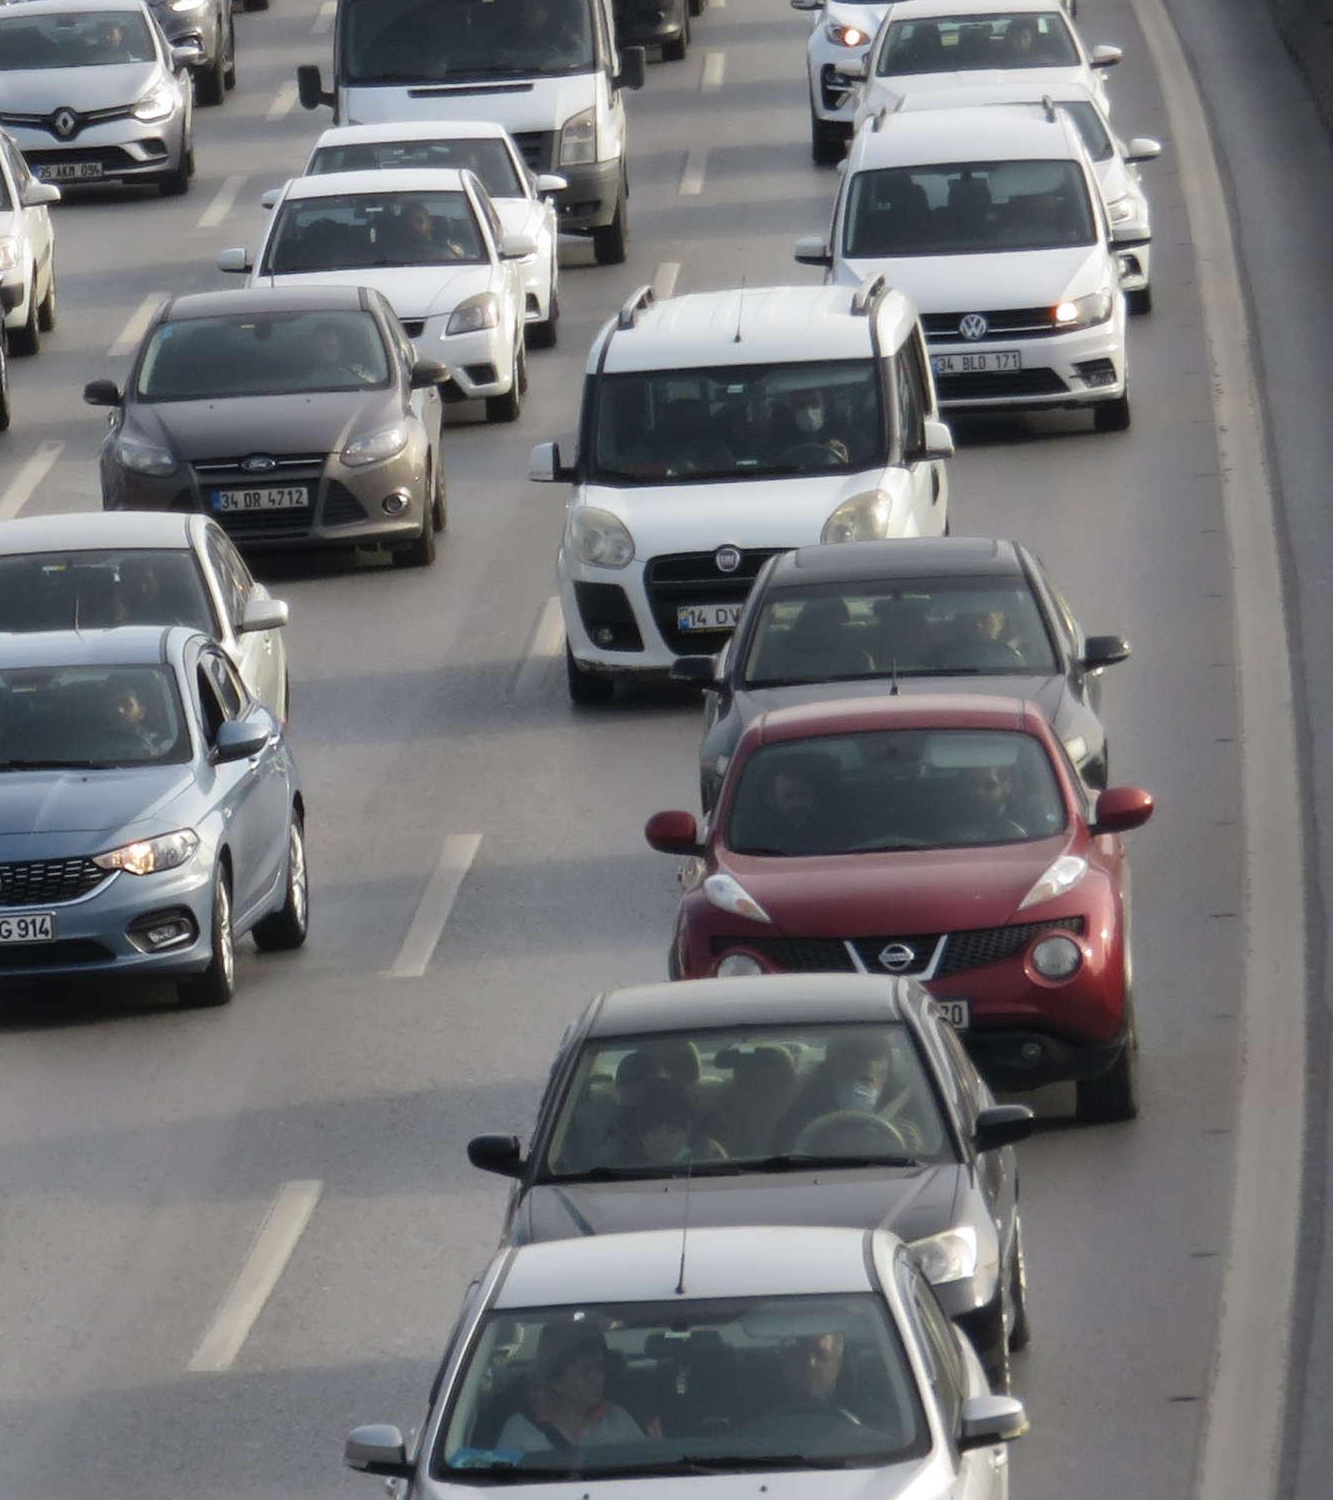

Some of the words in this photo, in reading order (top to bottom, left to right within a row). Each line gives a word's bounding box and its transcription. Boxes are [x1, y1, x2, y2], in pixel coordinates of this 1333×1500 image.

[938, 359, 954, 371] 34
[995, 354, 1017, 367] 171
[222, 492, 238, 508] 34
[269, 489, 303, 506] 4712
[690, 609, 706, 625] 14
[17, 918, 51, 938] 914
